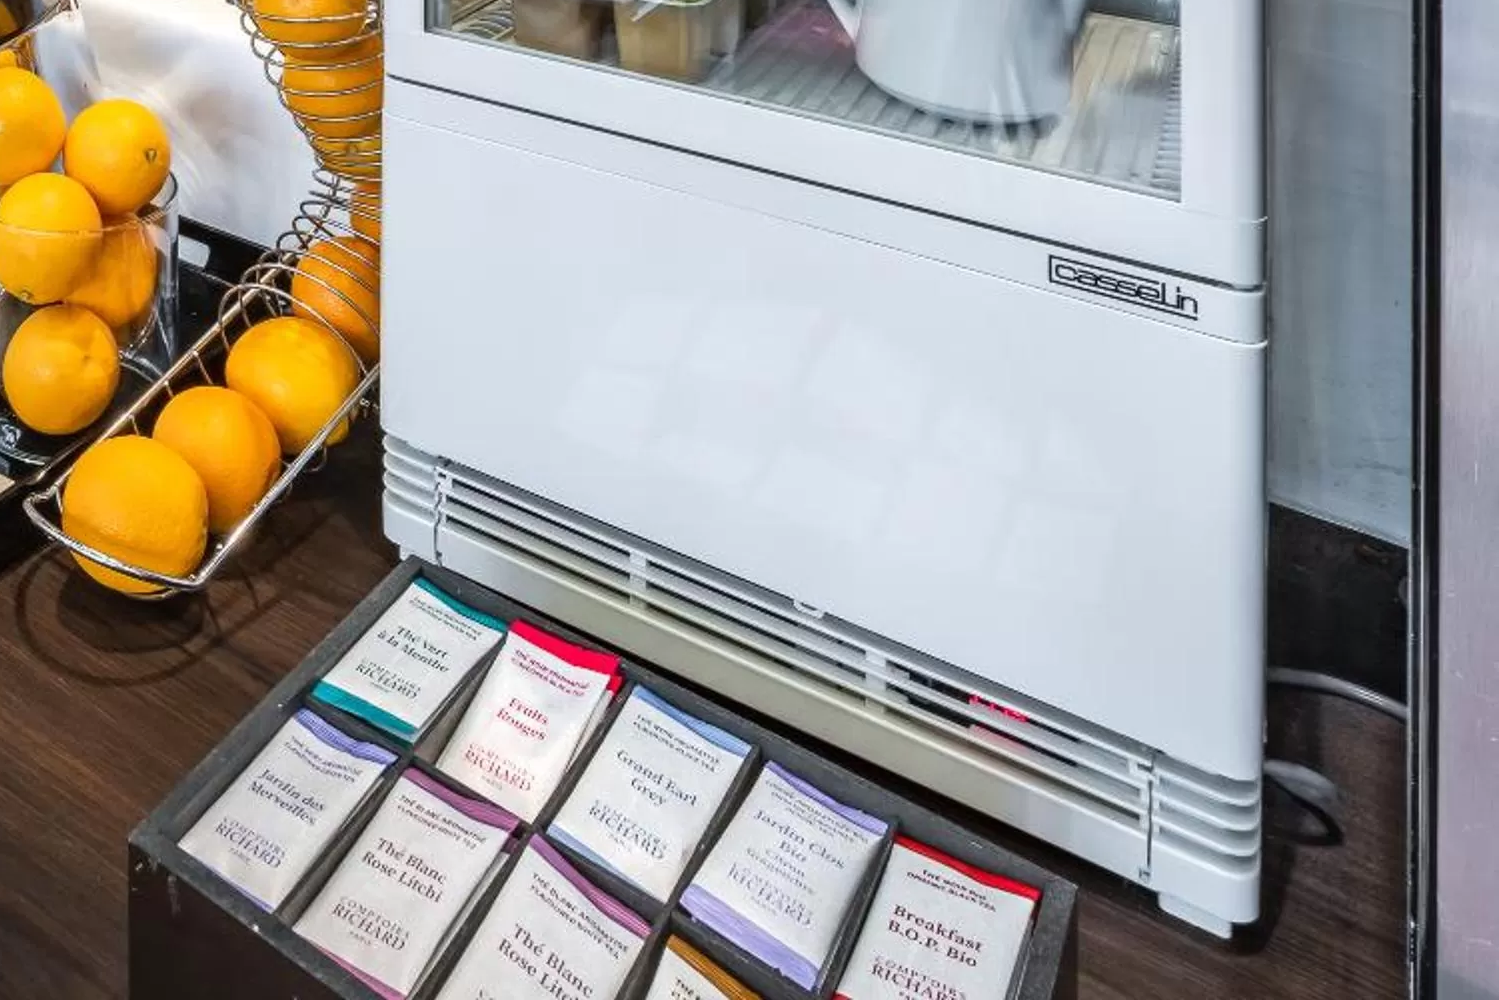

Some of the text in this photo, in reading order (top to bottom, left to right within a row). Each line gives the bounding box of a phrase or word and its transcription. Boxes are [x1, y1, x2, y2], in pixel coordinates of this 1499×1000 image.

[403, 644, 450, 673] Menthe
[496, 708, 547, 741] Rouges
[509, 697, 549, 725] Fruits
[257, 768, 325, 813] Jardin des
[464, 749, 532, 791] RICHARD
[616, 749, 698, 807] Grand Earl
[631, 777, 666, 807] Grey
[249, 780, 317, 827] Merveilles
[753, 809, 805, 845] Jardin
[214, 822, 282, 869] RICHARD
[589, 806, 664, 860] RICHARD
[361, 850, 443, 904] Rose Litchi
[377, 837, 447, 886] Thé Blanc
[331, 902, 405, 951] RICHARD
[888, 919, 977, 968] B.O.P. Bio
[893, 903, 984, 953] Breakfast
[498, 938, 580, 1000] Rose Litc
[513, 923, 594, 999] Thé Blanc
[871, 963, 954, 1000] RICHAR
